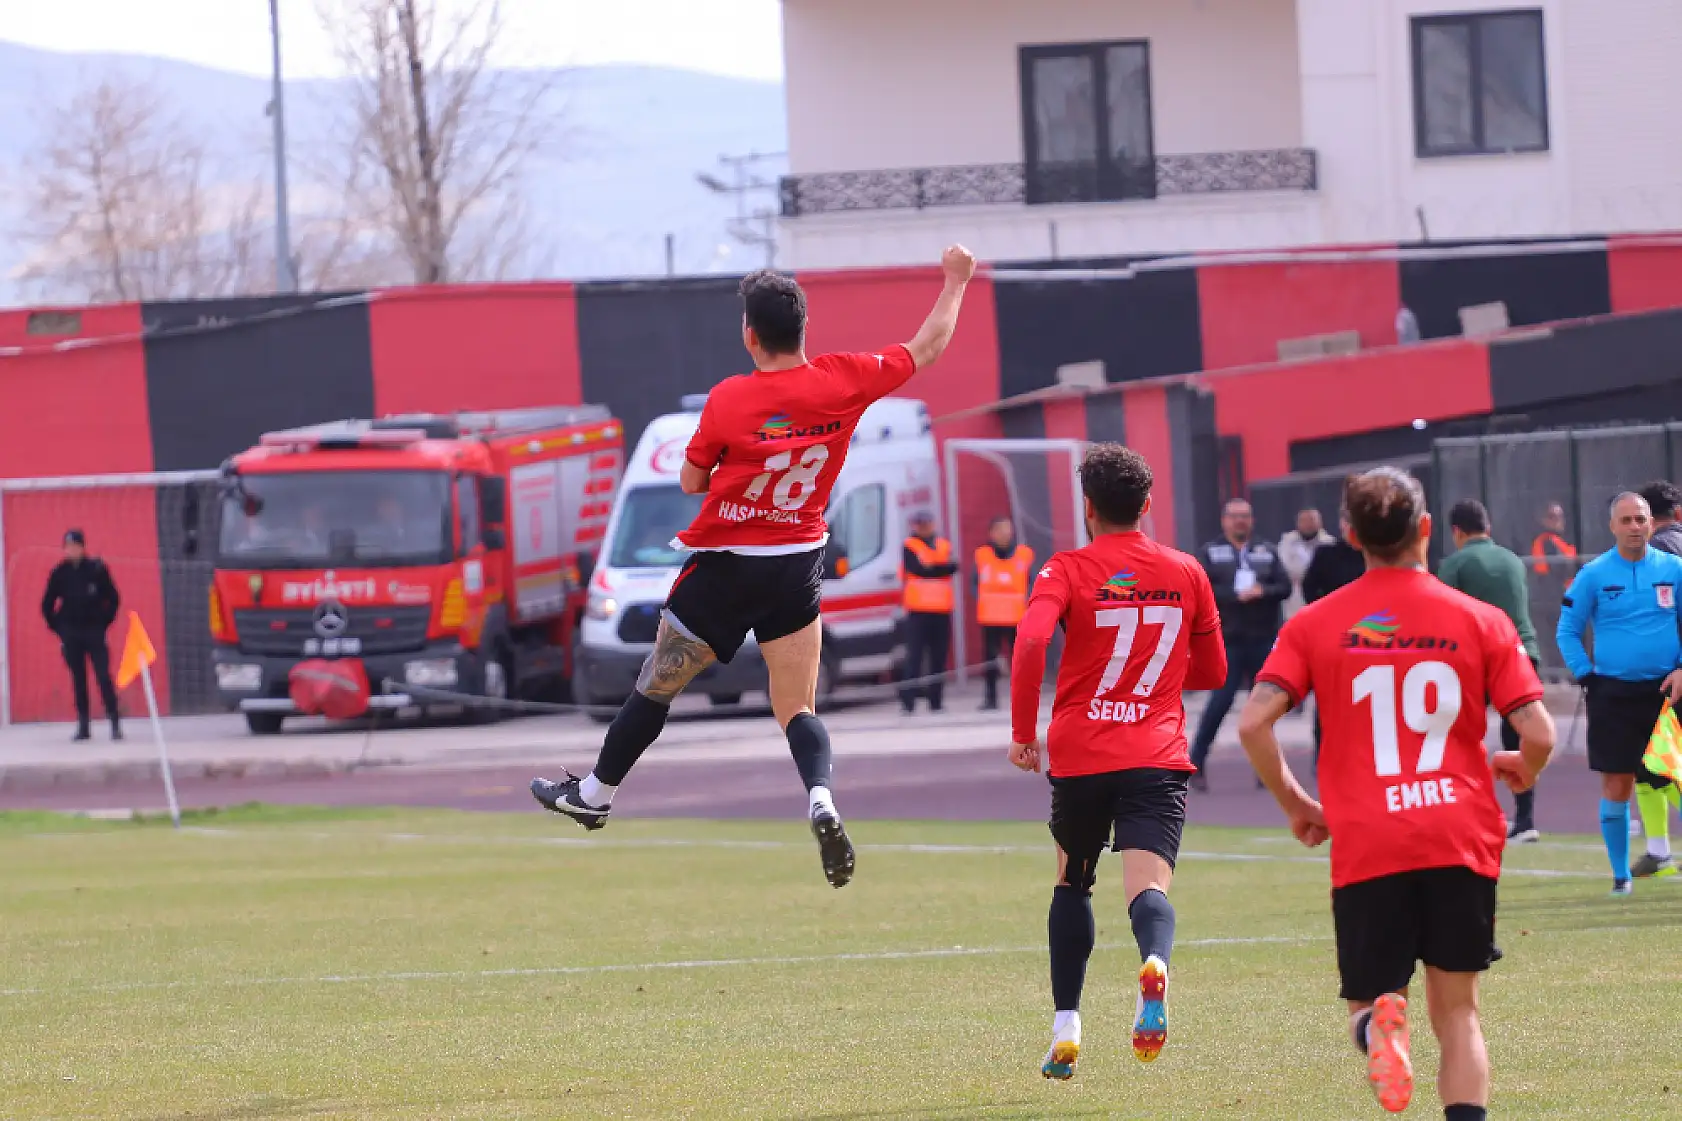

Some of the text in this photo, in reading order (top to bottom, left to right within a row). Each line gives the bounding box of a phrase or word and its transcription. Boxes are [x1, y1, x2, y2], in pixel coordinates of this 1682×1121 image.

[1095, 606, 1183, 698] 77
[1087, 698, 1151, 723] SEDAT
[1352, 661, 1462, 777] 19
[1385, 778, 1457, 813] EMRE
